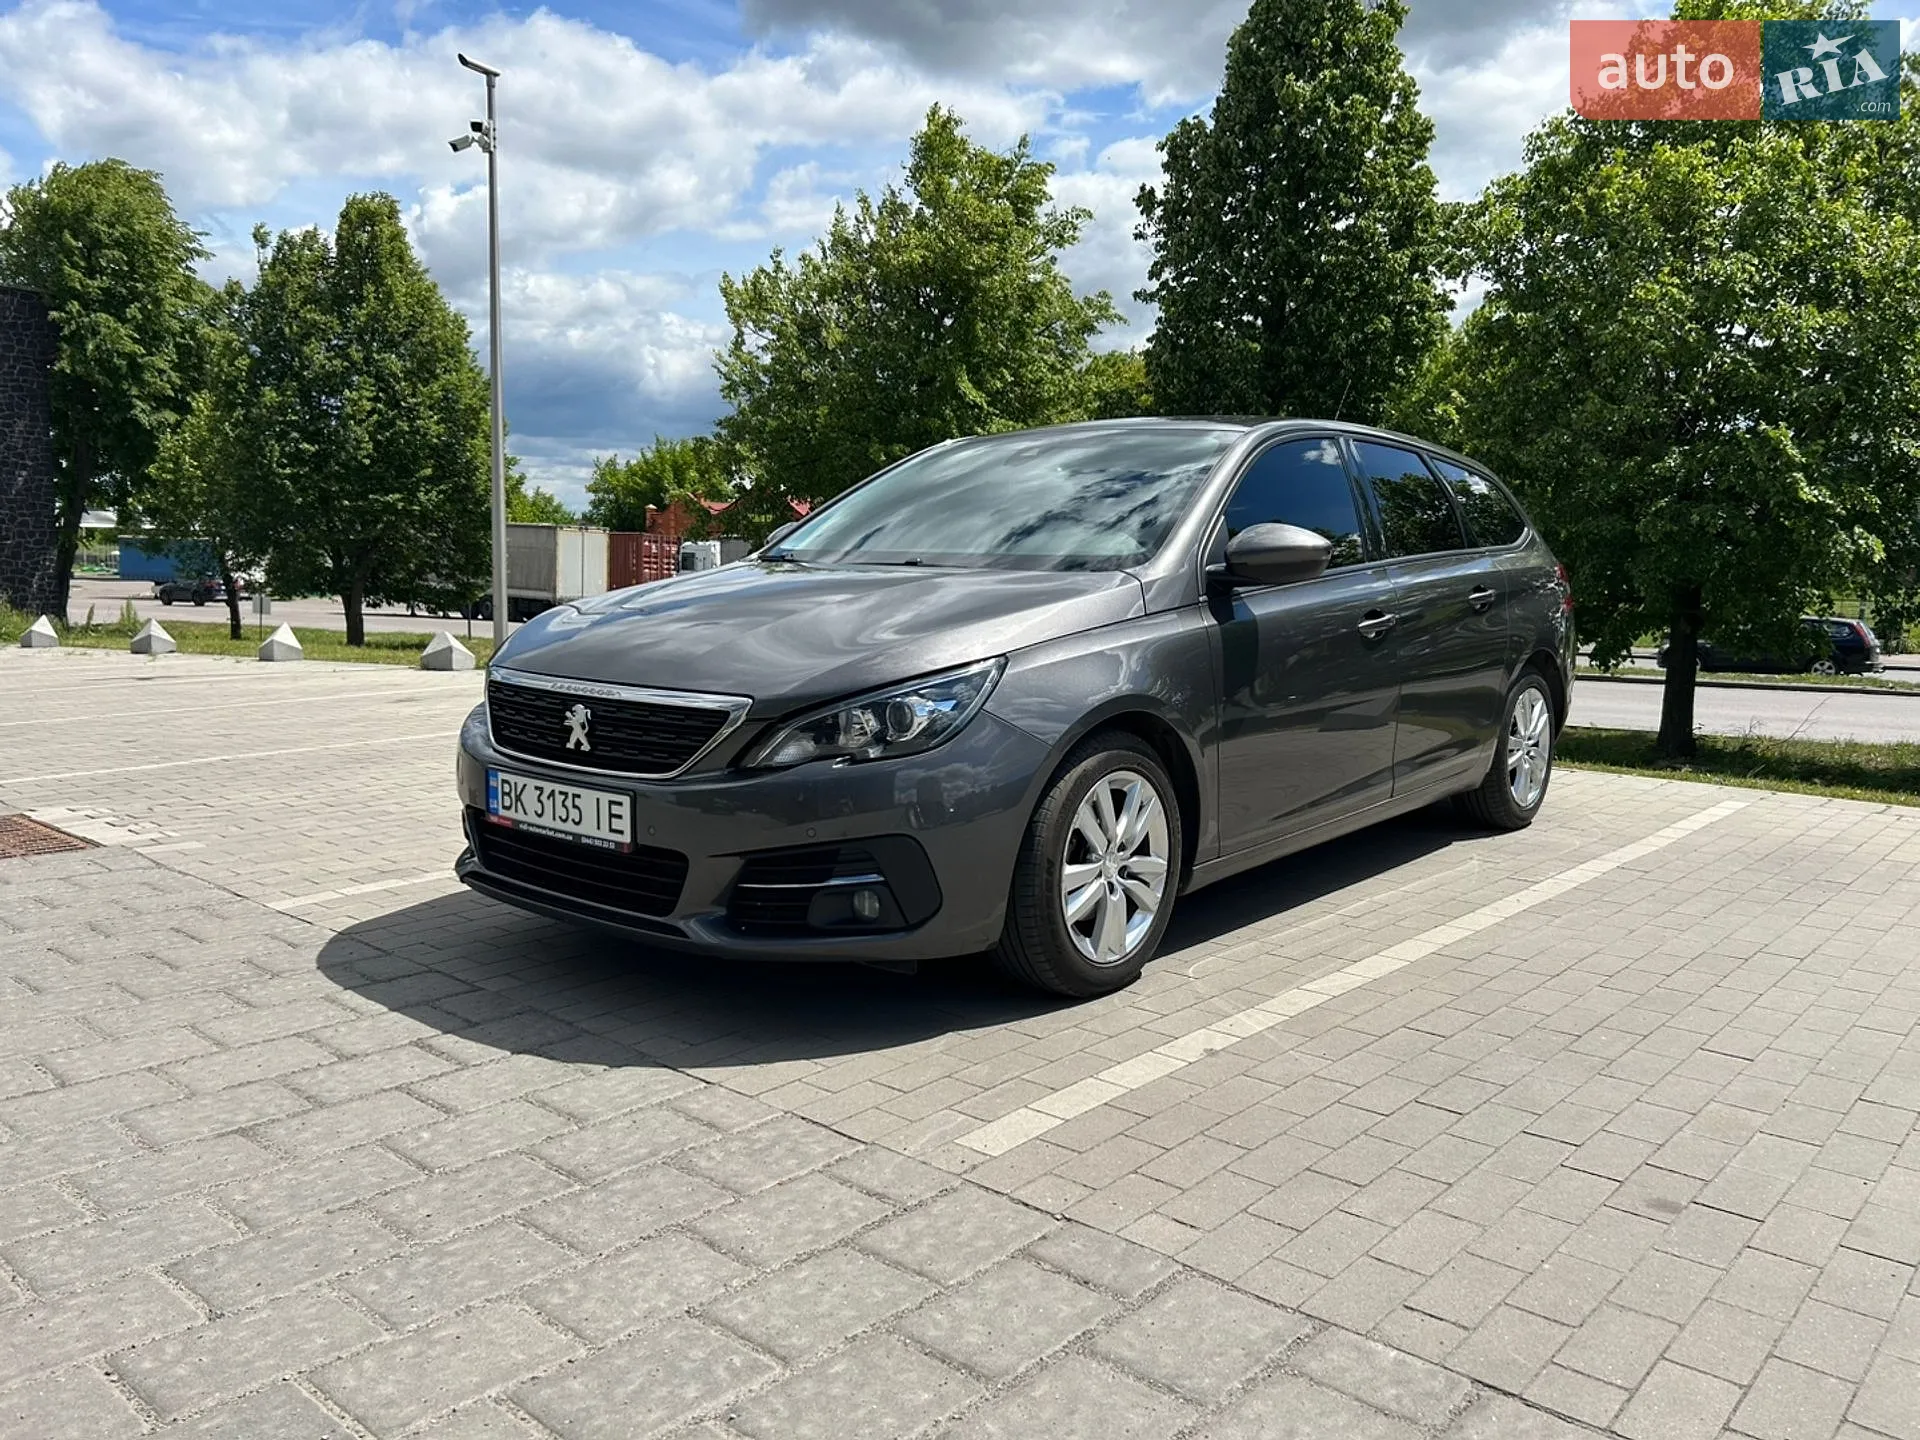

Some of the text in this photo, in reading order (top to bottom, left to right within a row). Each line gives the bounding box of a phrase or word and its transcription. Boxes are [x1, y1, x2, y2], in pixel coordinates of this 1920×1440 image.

[500, 778, 625, 836] BK 3135 IE
